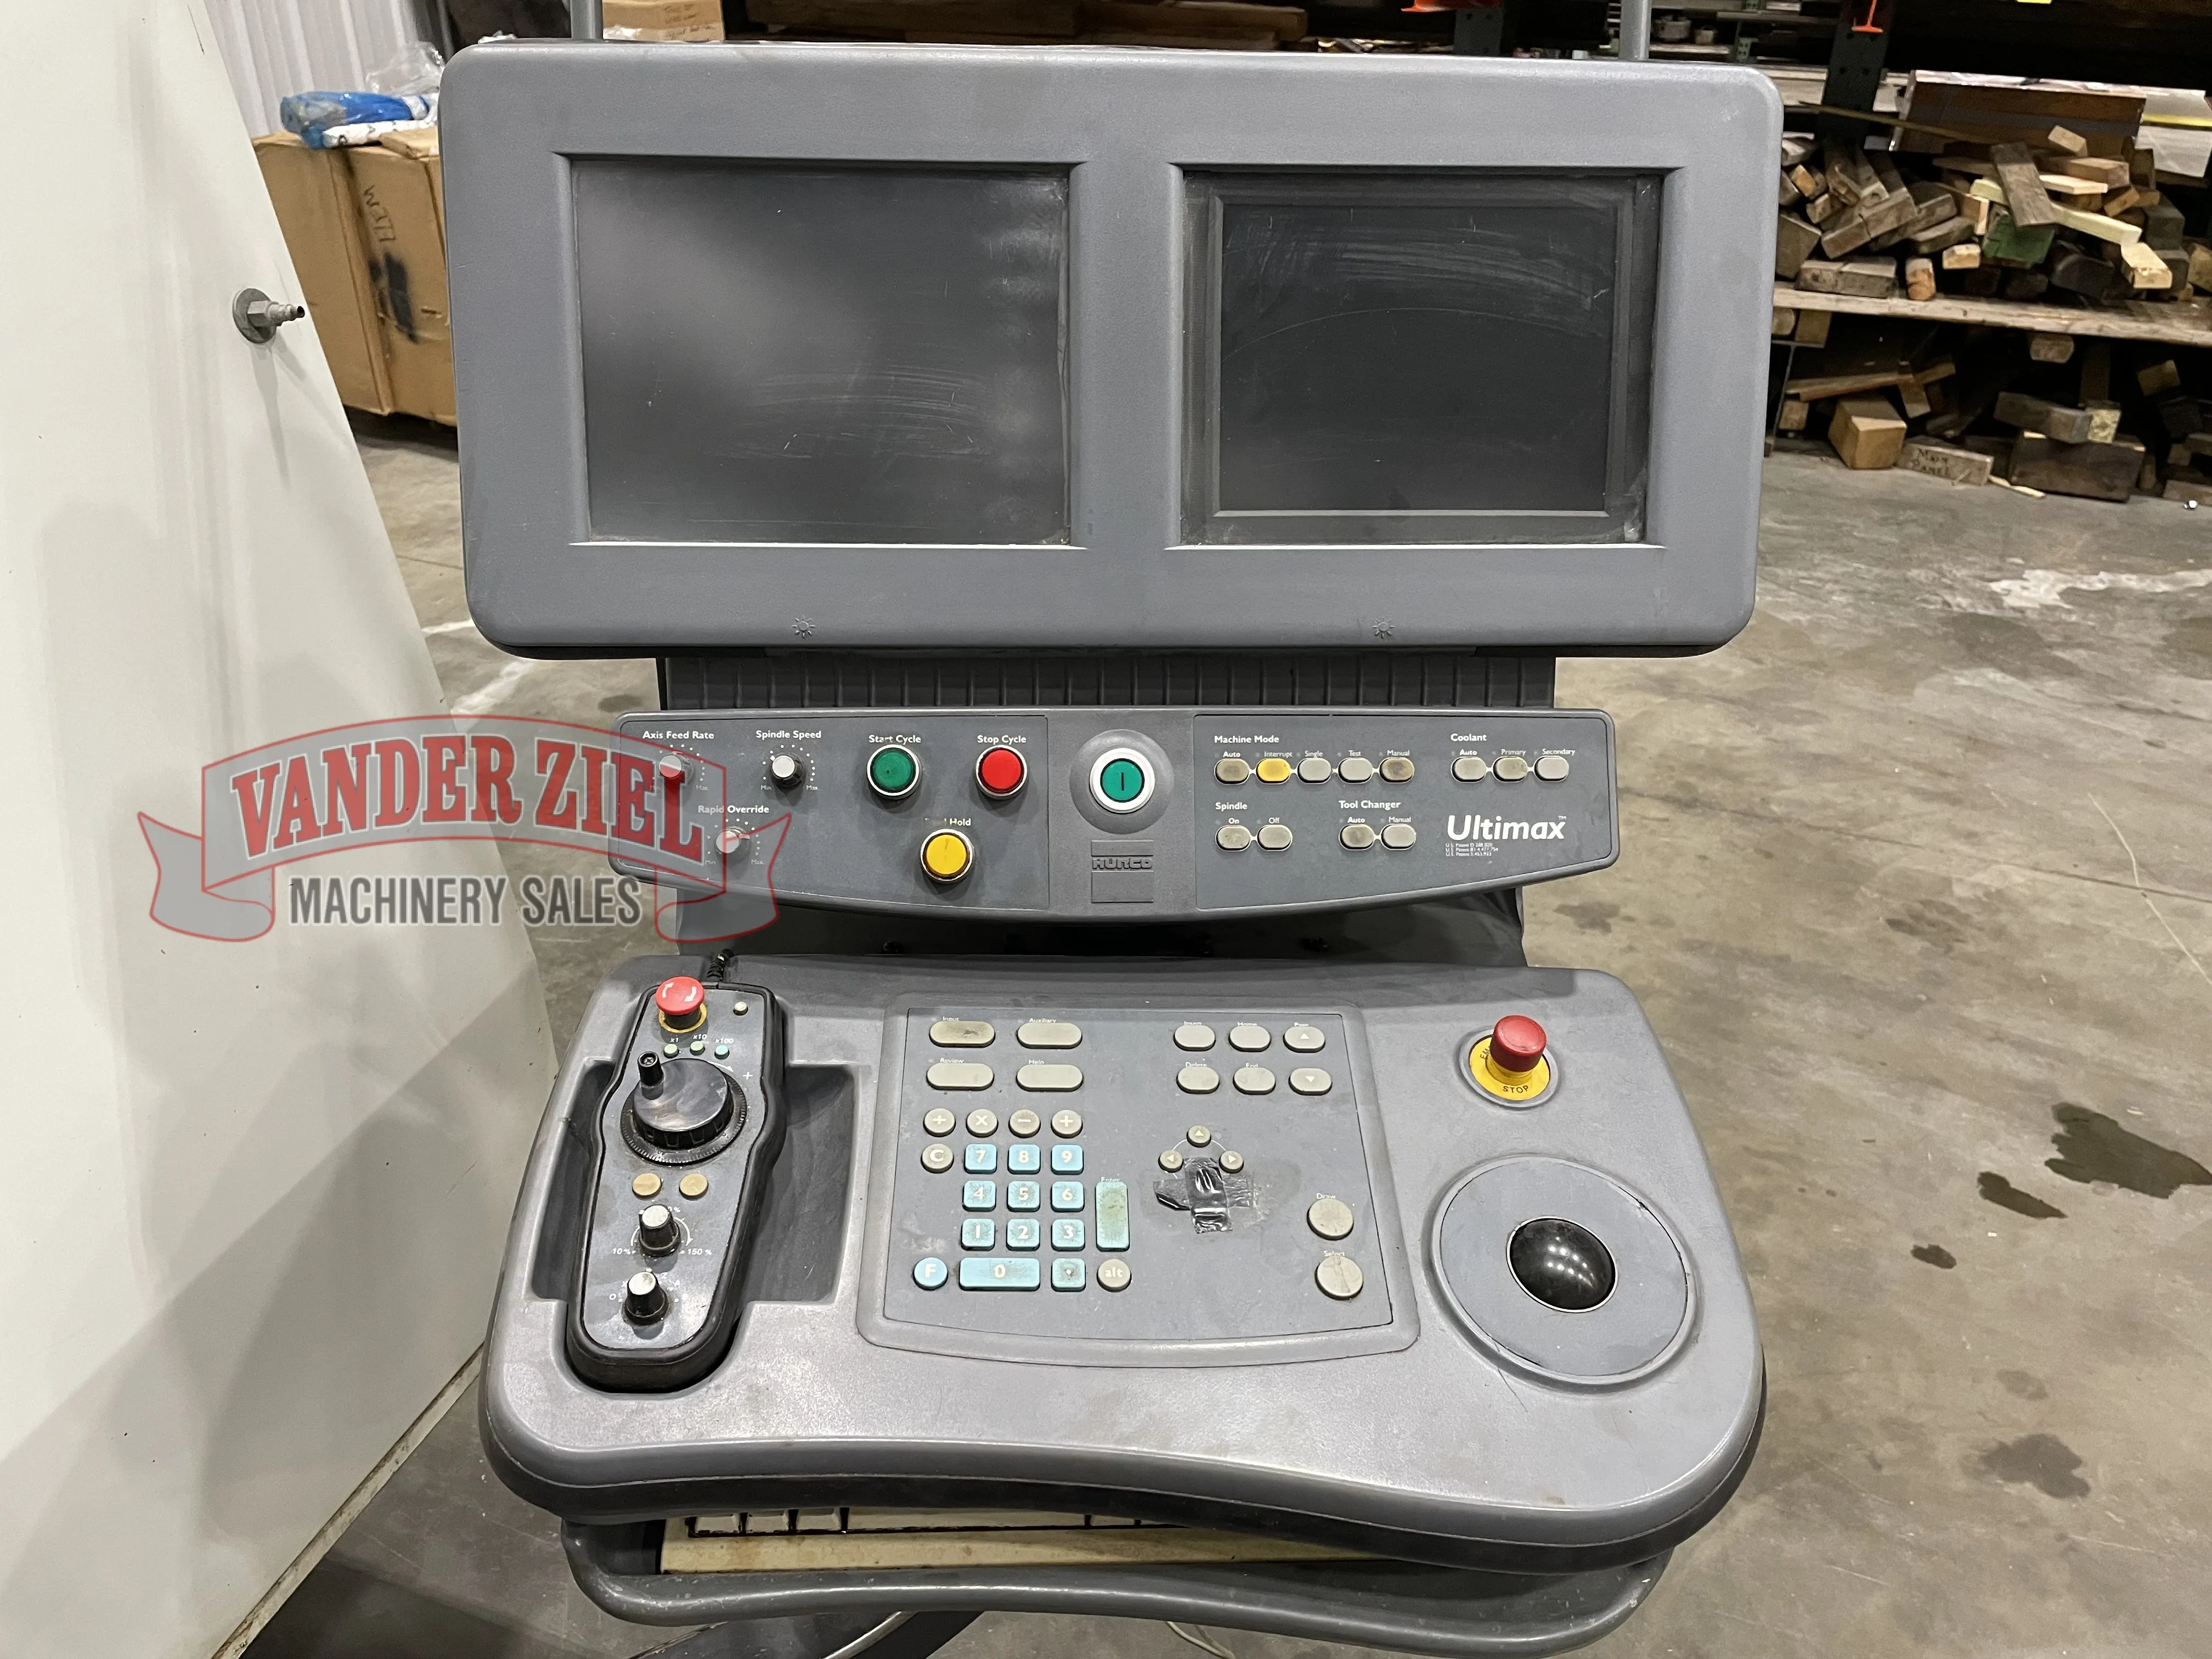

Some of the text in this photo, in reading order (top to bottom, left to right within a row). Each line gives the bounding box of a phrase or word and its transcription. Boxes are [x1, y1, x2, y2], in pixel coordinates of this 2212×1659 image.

[666, 731, 690, 739] Feed
[755, 730, 821, 739] Spindle Speed
[895, 735, 921, 745] Cycle
[977, 735, 1026, 745] Stop Cycle
[1214, 735, 1279, 743] Machine Mode
[1451, 733, 1487, 741] Coolant
[1305, 750, 1323, 758] Single
[698, 805, 770, 815] Rapid Override
[1215, 802, 1248, 811] Spindle
[1339, 800, 1401, 811] Tool Changer
[950, 818, 971, 826] Hold
[1447, 815, 1566, 840] Ultimax
[1092, 857, 1153, 870] HURCO
[1503, 1085, 1529, 1093] STOP
[929, 1149, 944, 1162] C
[975, 1150, 986, 1163] 7
[1018, 1150, 1029, 1163] 8
[1062, 1150, 1073, 1163] 9
[973, 1187, 984, 1200] 4
[1018, 1187, 1029, 1201] 5
[1062, 1188, 1073, 1201] 6
[975, 1225, 981, 1239] 1
[1018, 1225, 1029, 1239] 2
[1063, 1224, 1074, 1239] 3
[925, 1263, 937, 1277] F
[994, 1264, 1006, 1278] 0
[1105, 1267, 1124, 1278] alt
